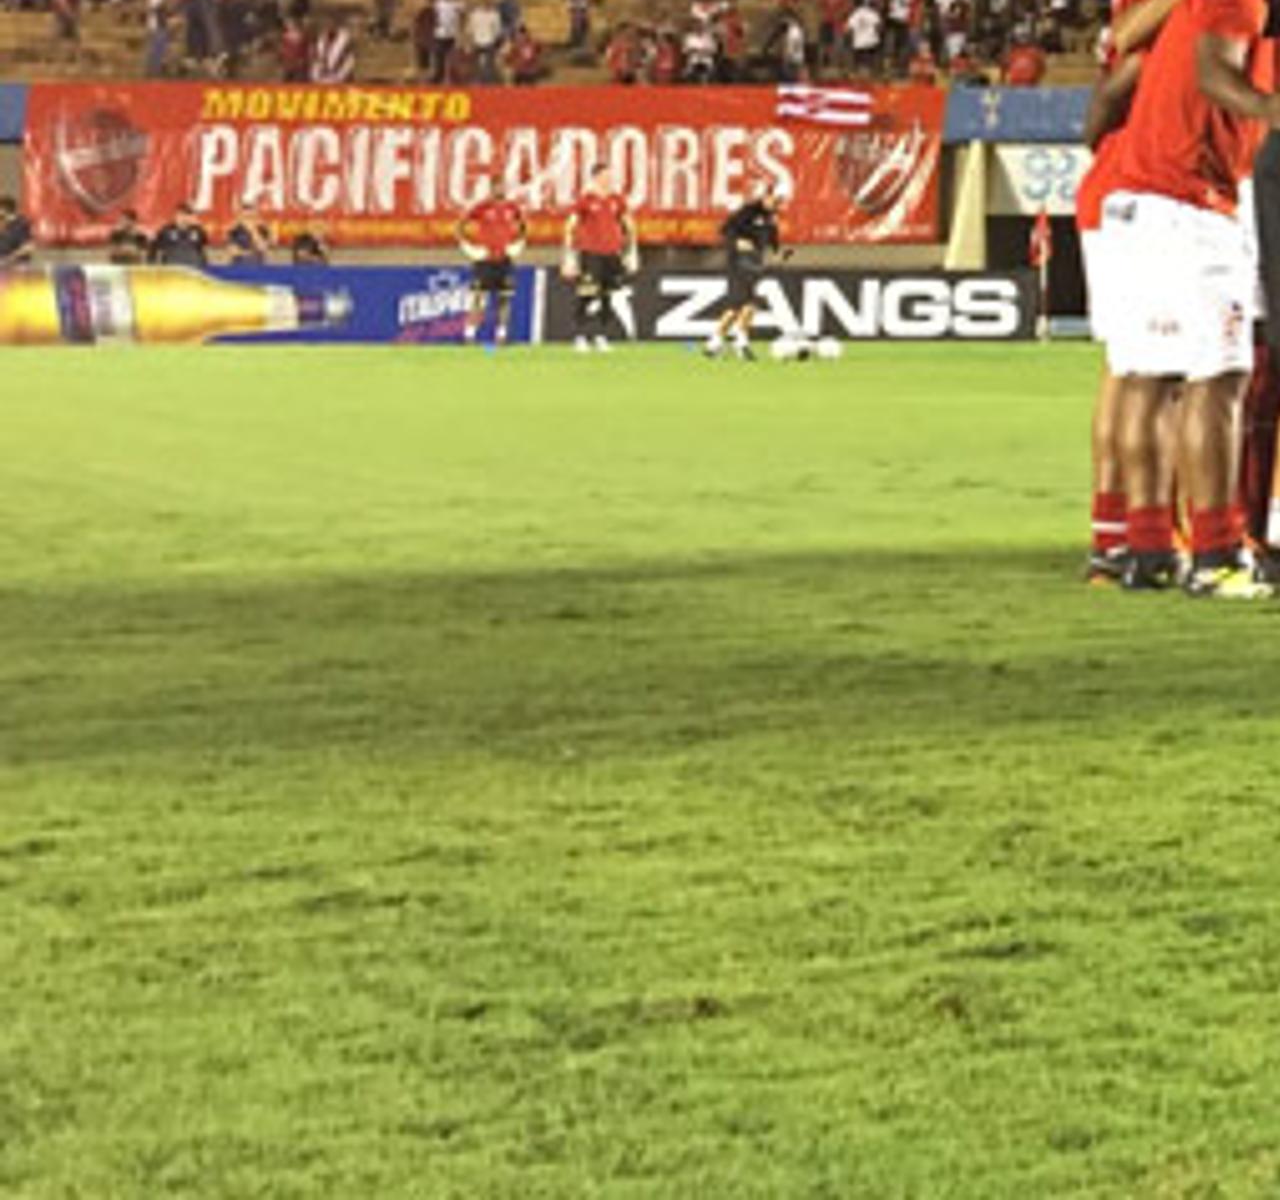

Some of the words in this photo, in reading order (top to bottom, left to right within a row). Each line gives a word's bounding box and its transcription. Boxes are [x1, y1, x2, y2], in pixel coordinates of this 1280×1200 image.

[203, 88, 471, 121] MOVIMENTO
[194, 125, 796, 212] PACIFICADORES
[655, 277, 1019, 337] ZANGS
